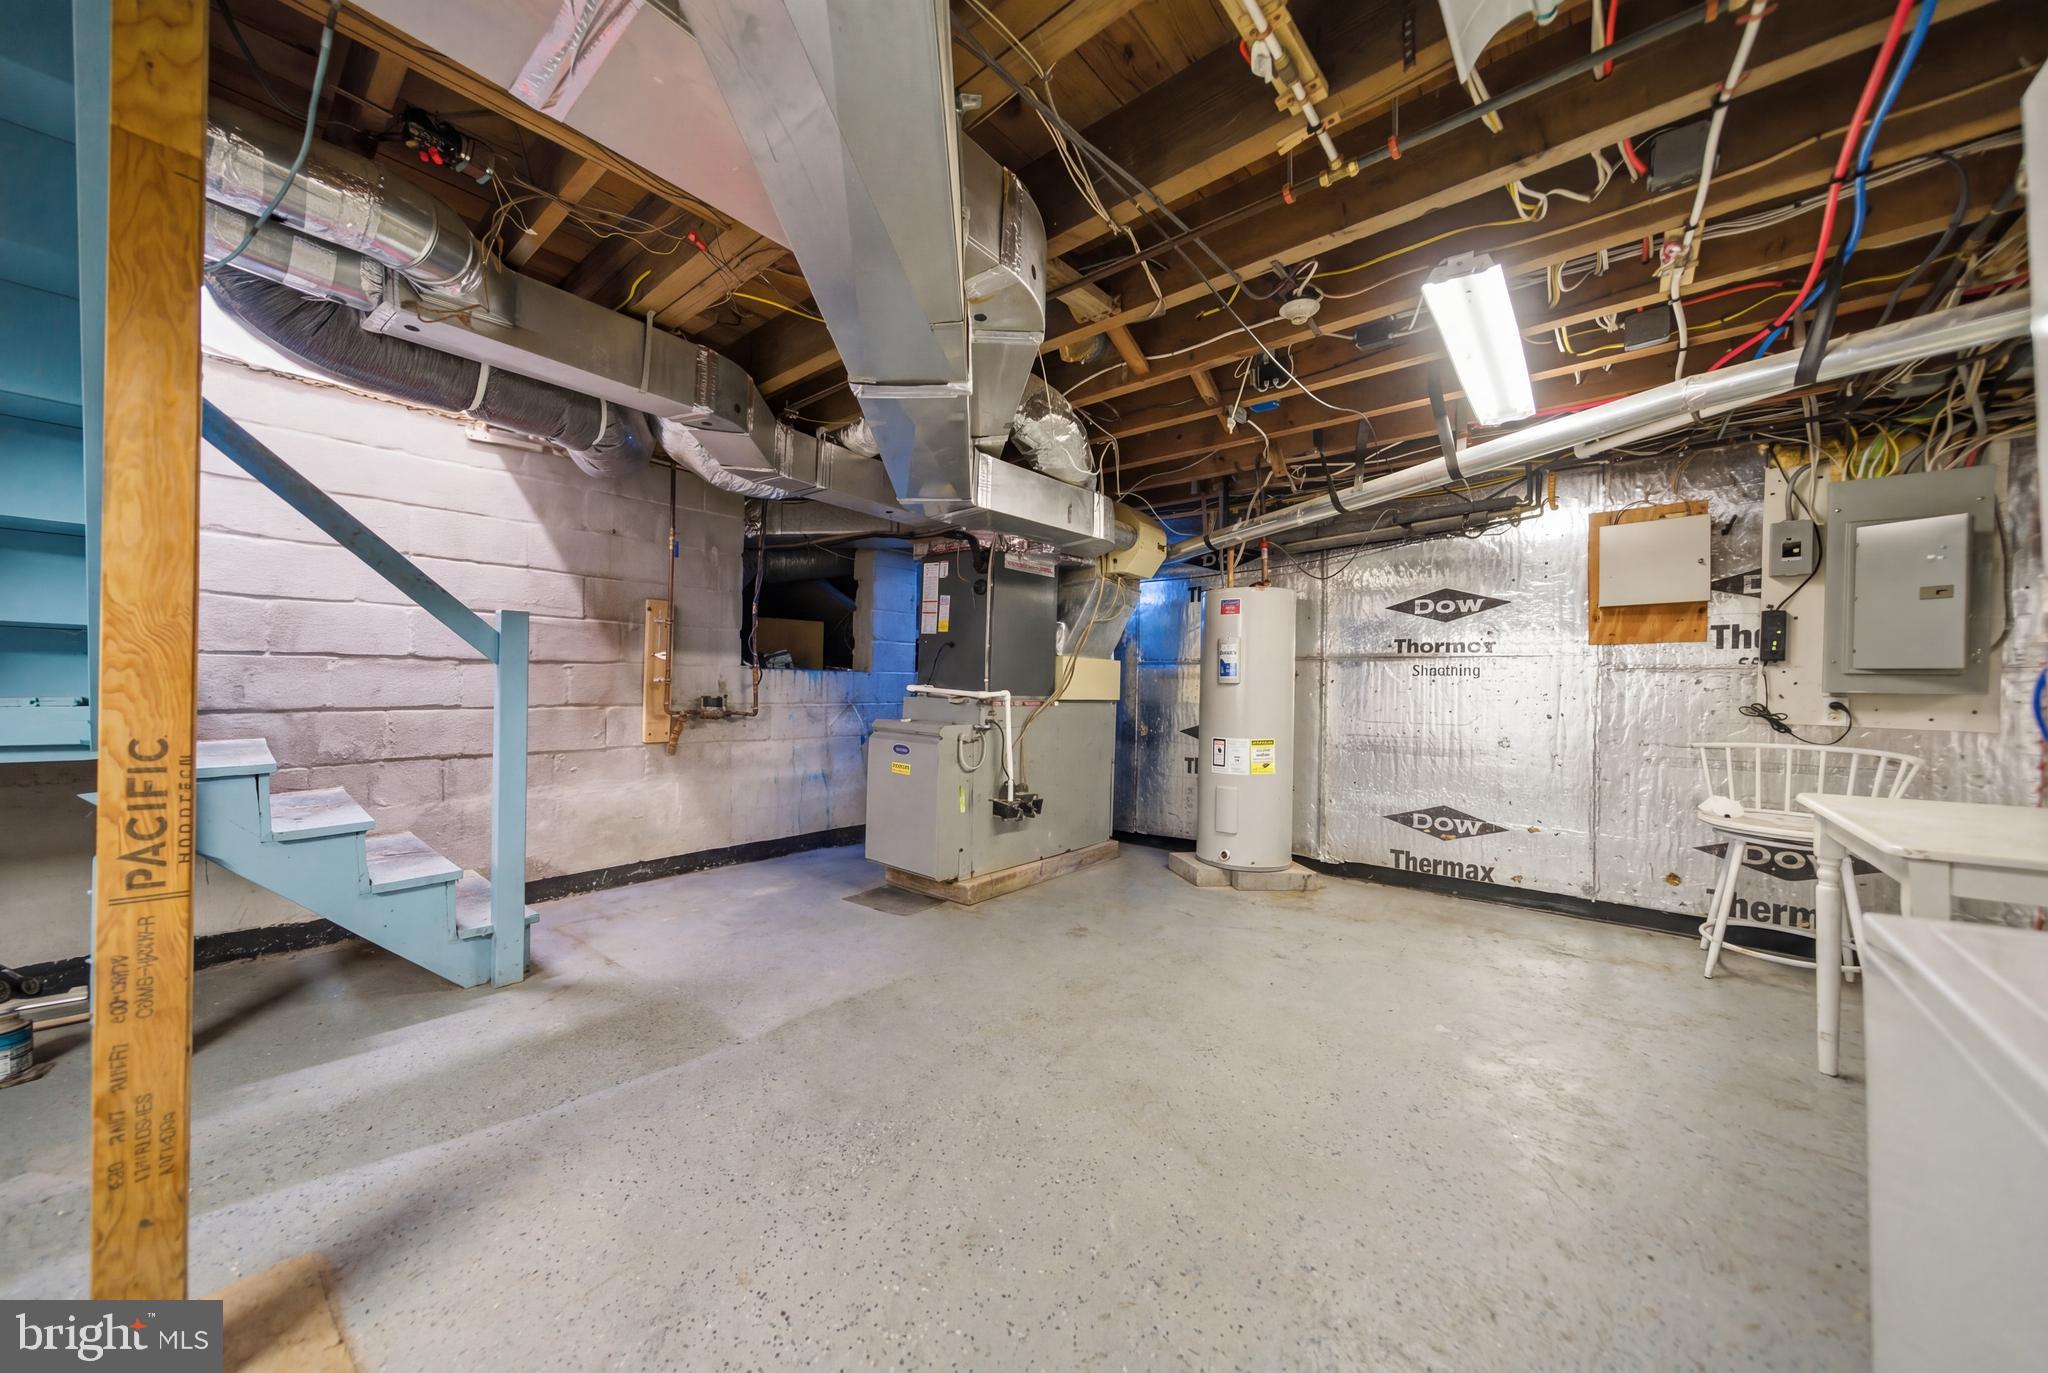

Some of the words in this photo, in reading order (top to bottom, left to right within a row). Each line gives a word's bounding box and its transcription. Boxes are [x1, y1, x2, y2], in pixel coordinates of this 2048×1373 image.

[1414, 599, 1485, 614] DOW
[116, 738, 168, 891] PACIFIC
[1412, 813, 1485, 835] DOW
[1389, 848, 1495, 883] Thermax
[1743, 845, 1818, 874] DO
